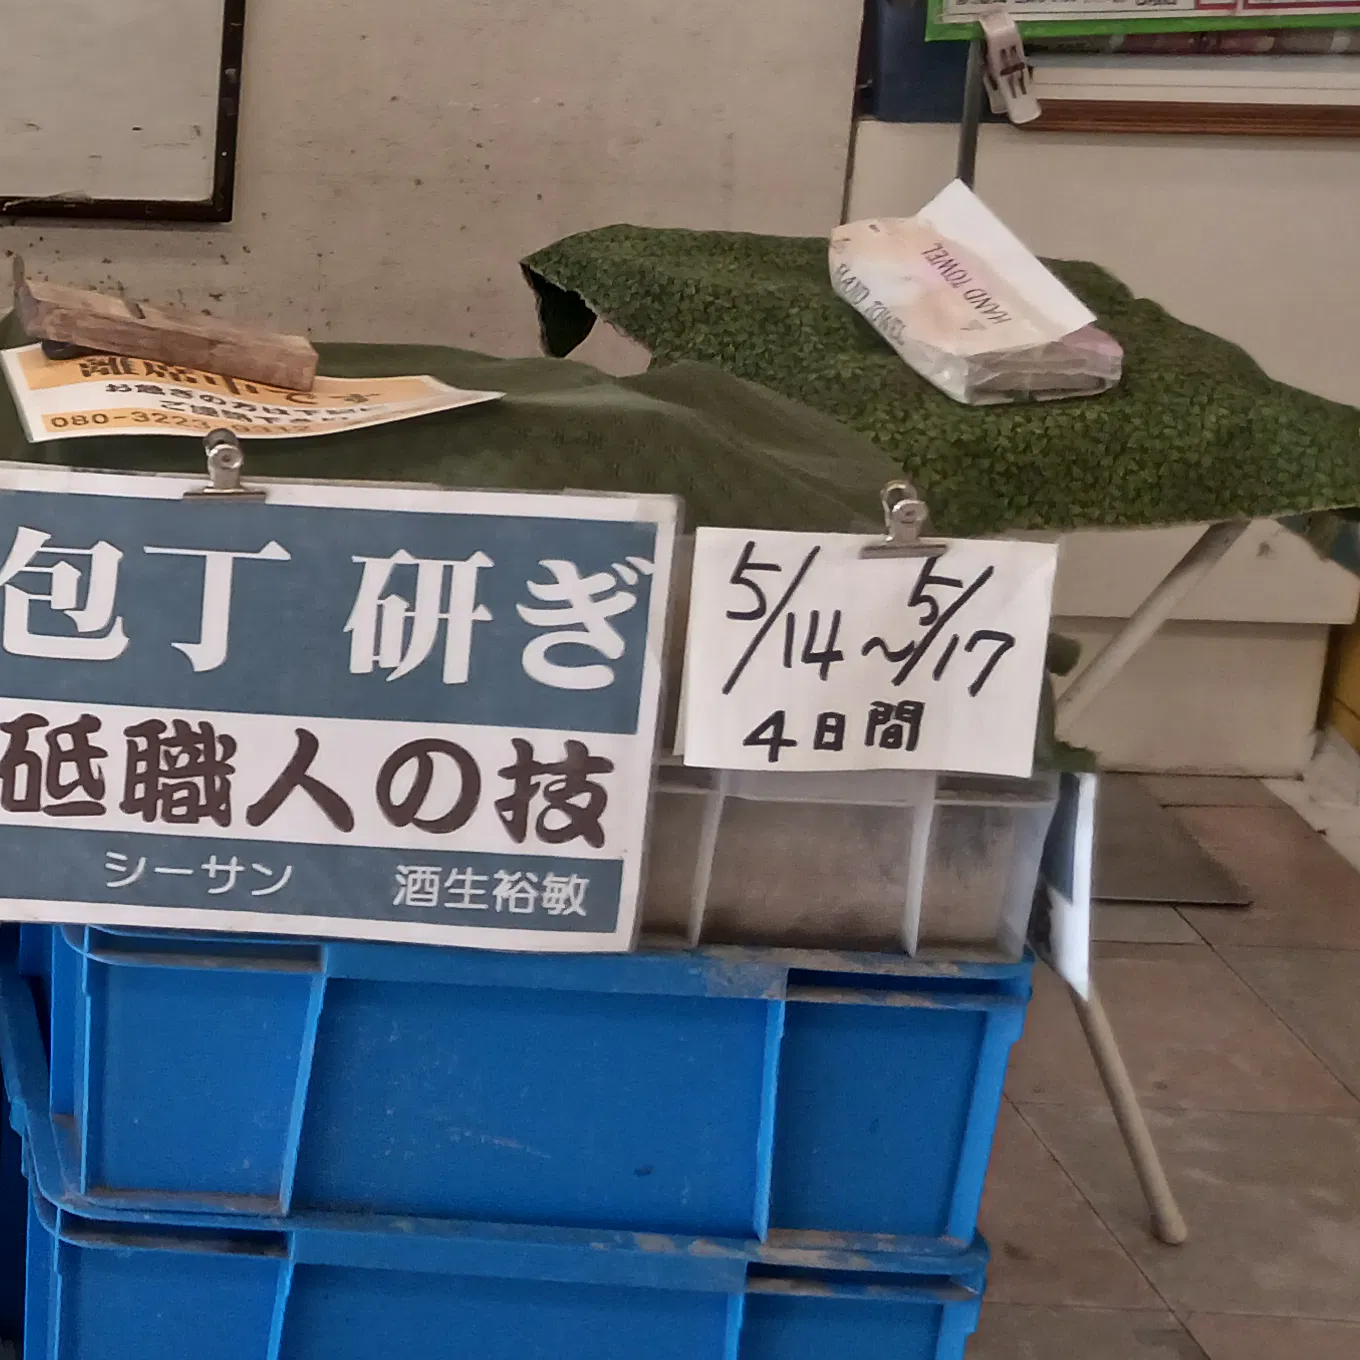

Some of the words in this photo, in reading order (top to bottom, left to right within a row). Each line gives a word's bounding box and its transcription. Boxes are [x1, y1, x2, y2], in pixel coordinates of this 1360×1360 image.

[920, 241, 973, 289] TOWEL
[962, 288, 1012, 325] HAND
[346, 547, 659, 692] 研ぎ
[742, 700, 925, 754] 4日間
[102, 849, 294, 898] シーサン
[392, 863, 589, 920] 酒生裕敏
